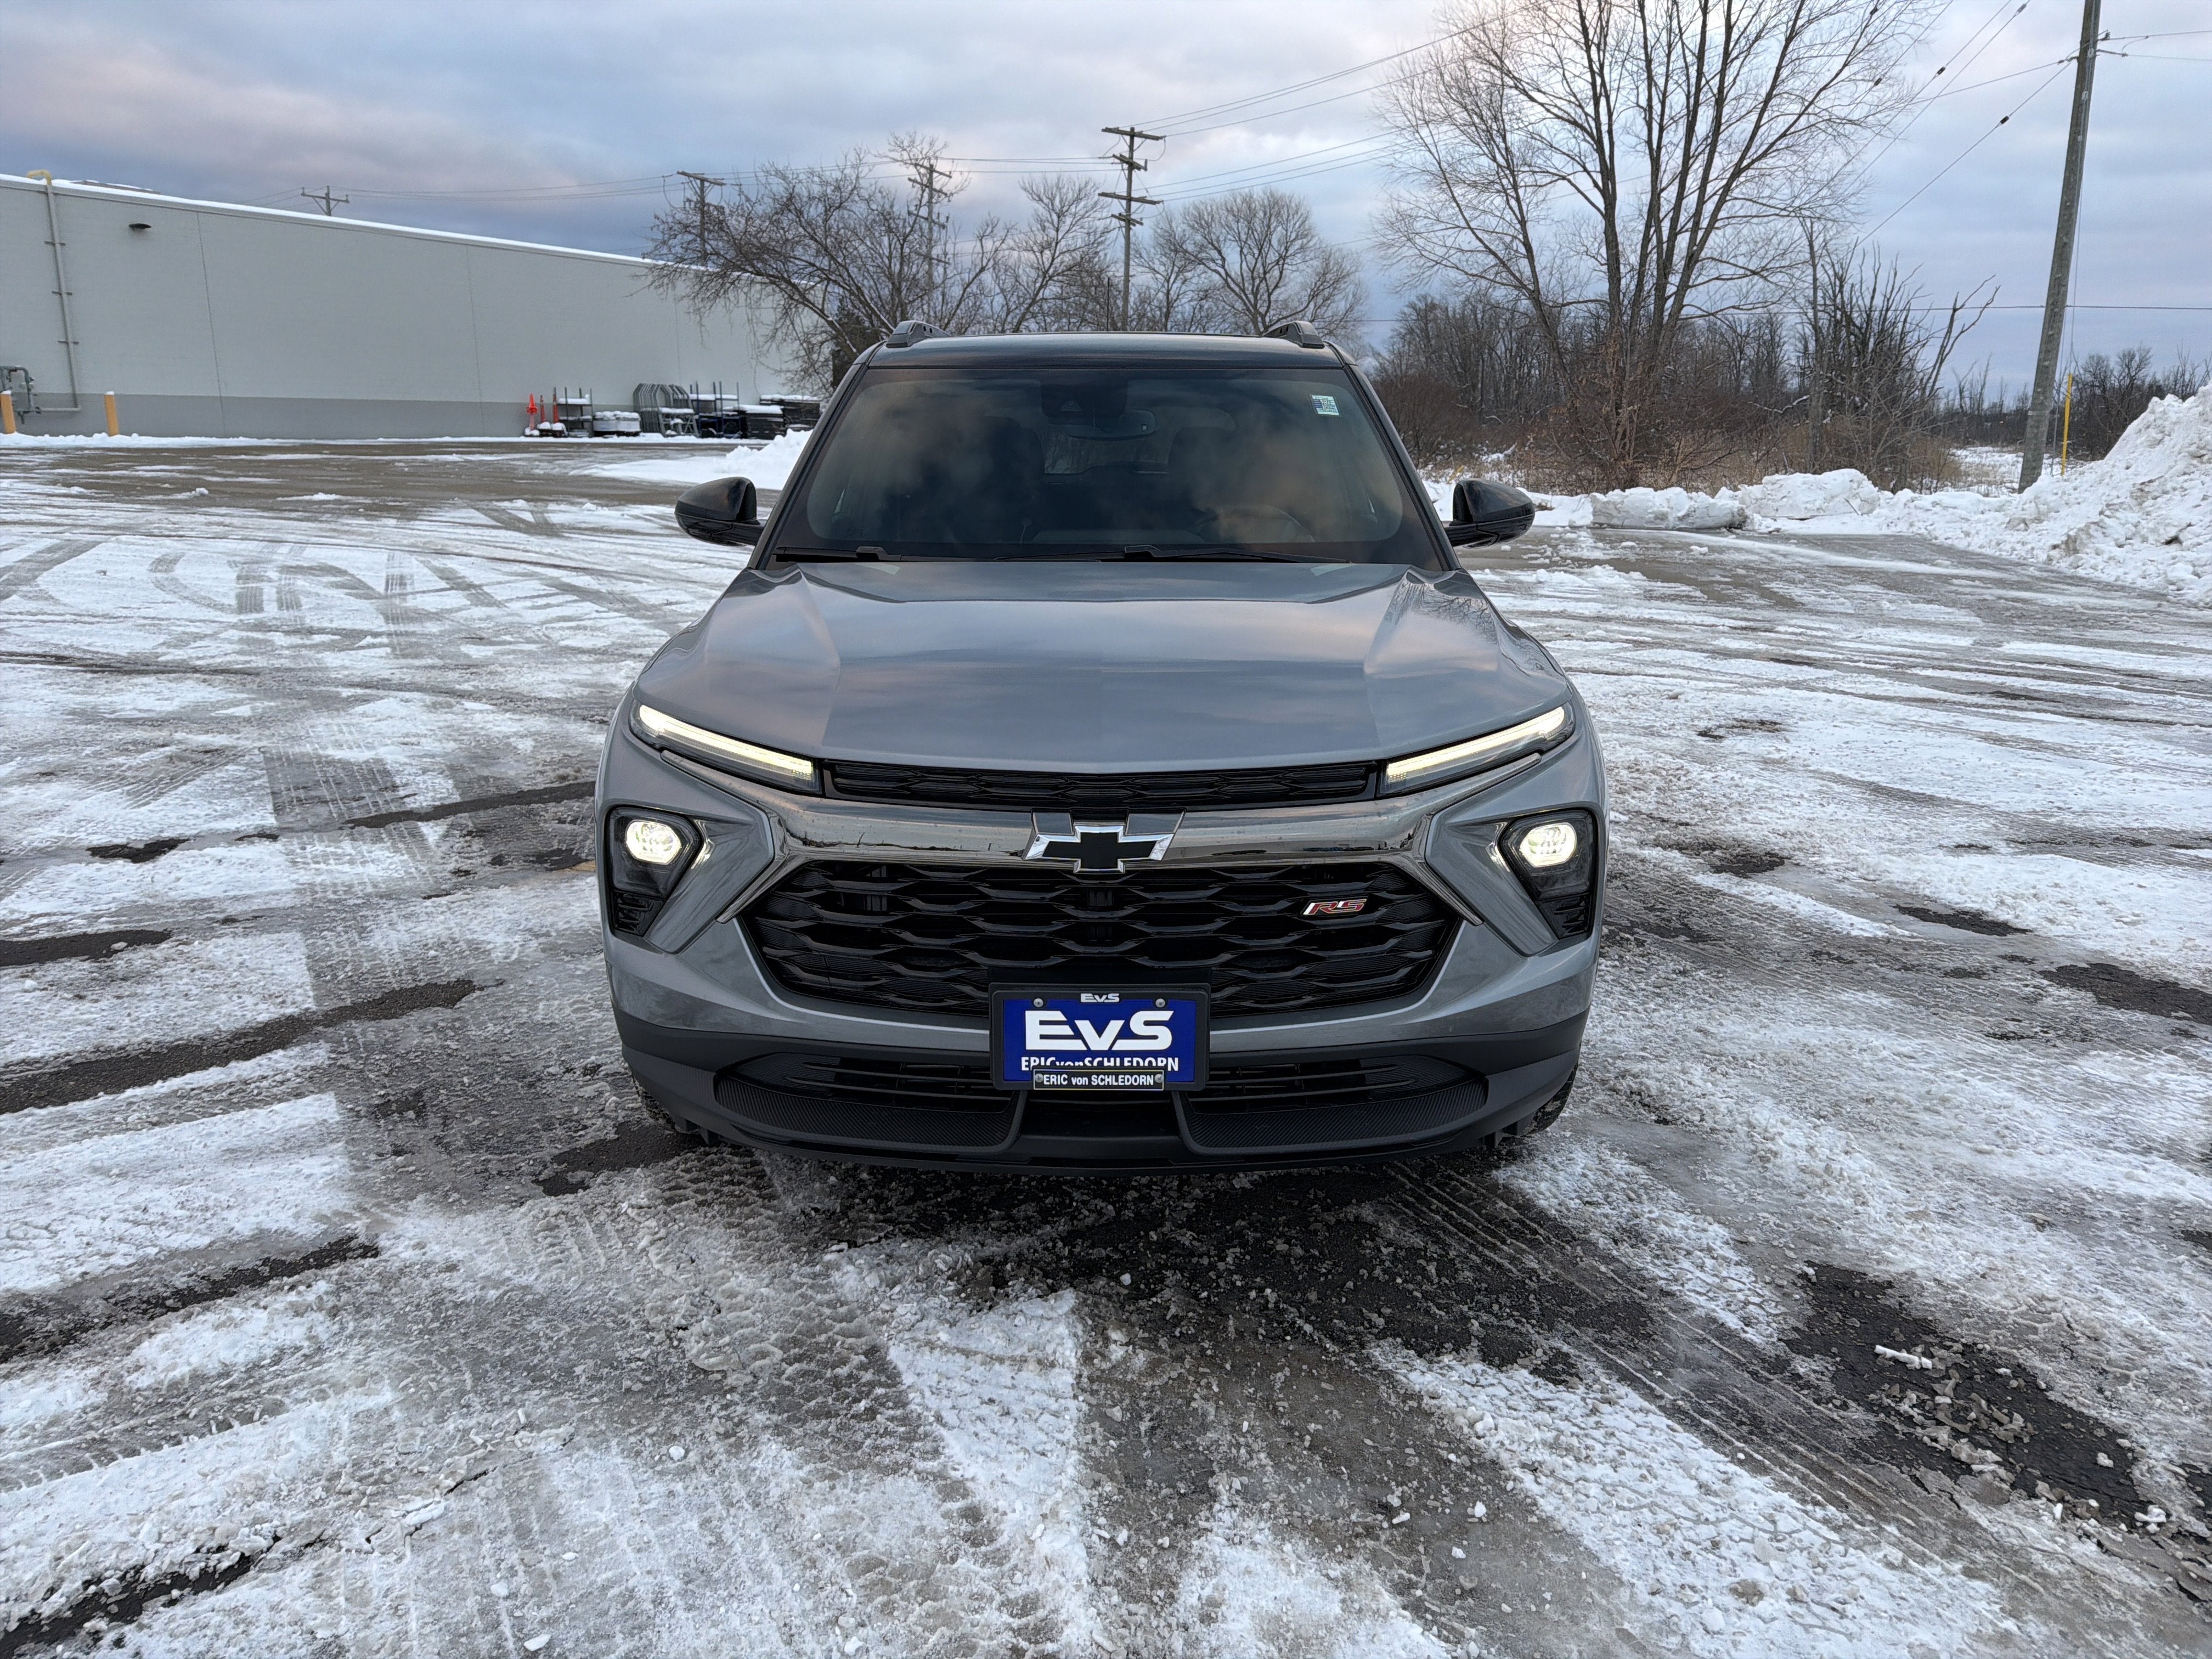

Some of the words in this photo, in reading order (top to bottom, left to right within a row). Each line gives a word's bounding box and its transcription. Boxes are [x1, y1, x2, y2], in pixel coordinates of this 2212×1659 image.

[1303, 899, 1367, 915] RS
[1043, 1074, 1068, 1085] ERIC
[1071, 1077, 1088, 1085] von
[1091, 1075, 1154, 1086] SCHLEDORN
